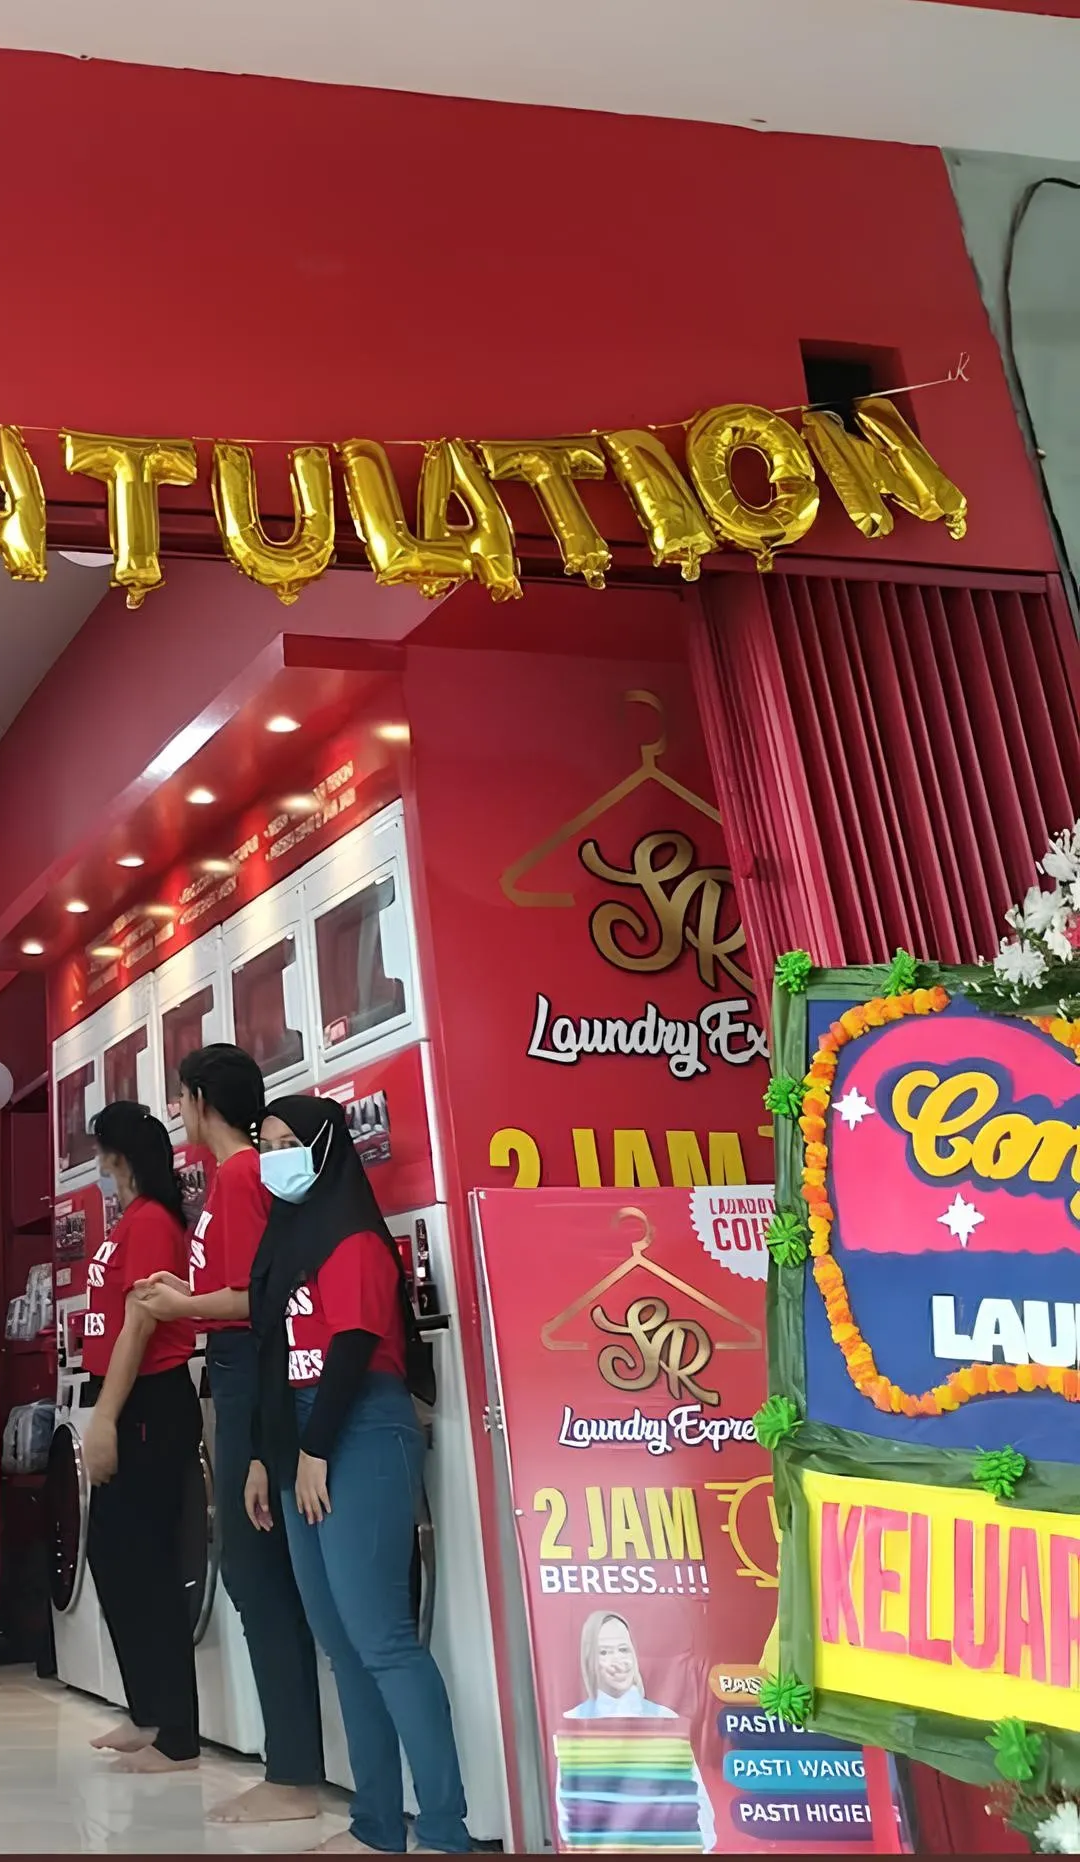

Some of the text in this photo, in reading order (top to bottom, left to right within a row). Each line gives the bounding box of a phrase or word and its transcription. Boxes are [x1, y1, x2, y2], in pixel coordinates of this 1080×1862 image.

[527, 992, 707, 1078] Laundry
[892, 1069, 1080, 1184] Con
[932, 1295, 1080, 1368] LAU
[558, 1405, 673, 1455] Laundry
[533, 1487, 705, 1561] 2 JAM
[726, 1715, 786, 1733] PASTI
[733, 1759, 865, 1778] PASTI WANG
[739, 1803, 800, 1823] PASTI
